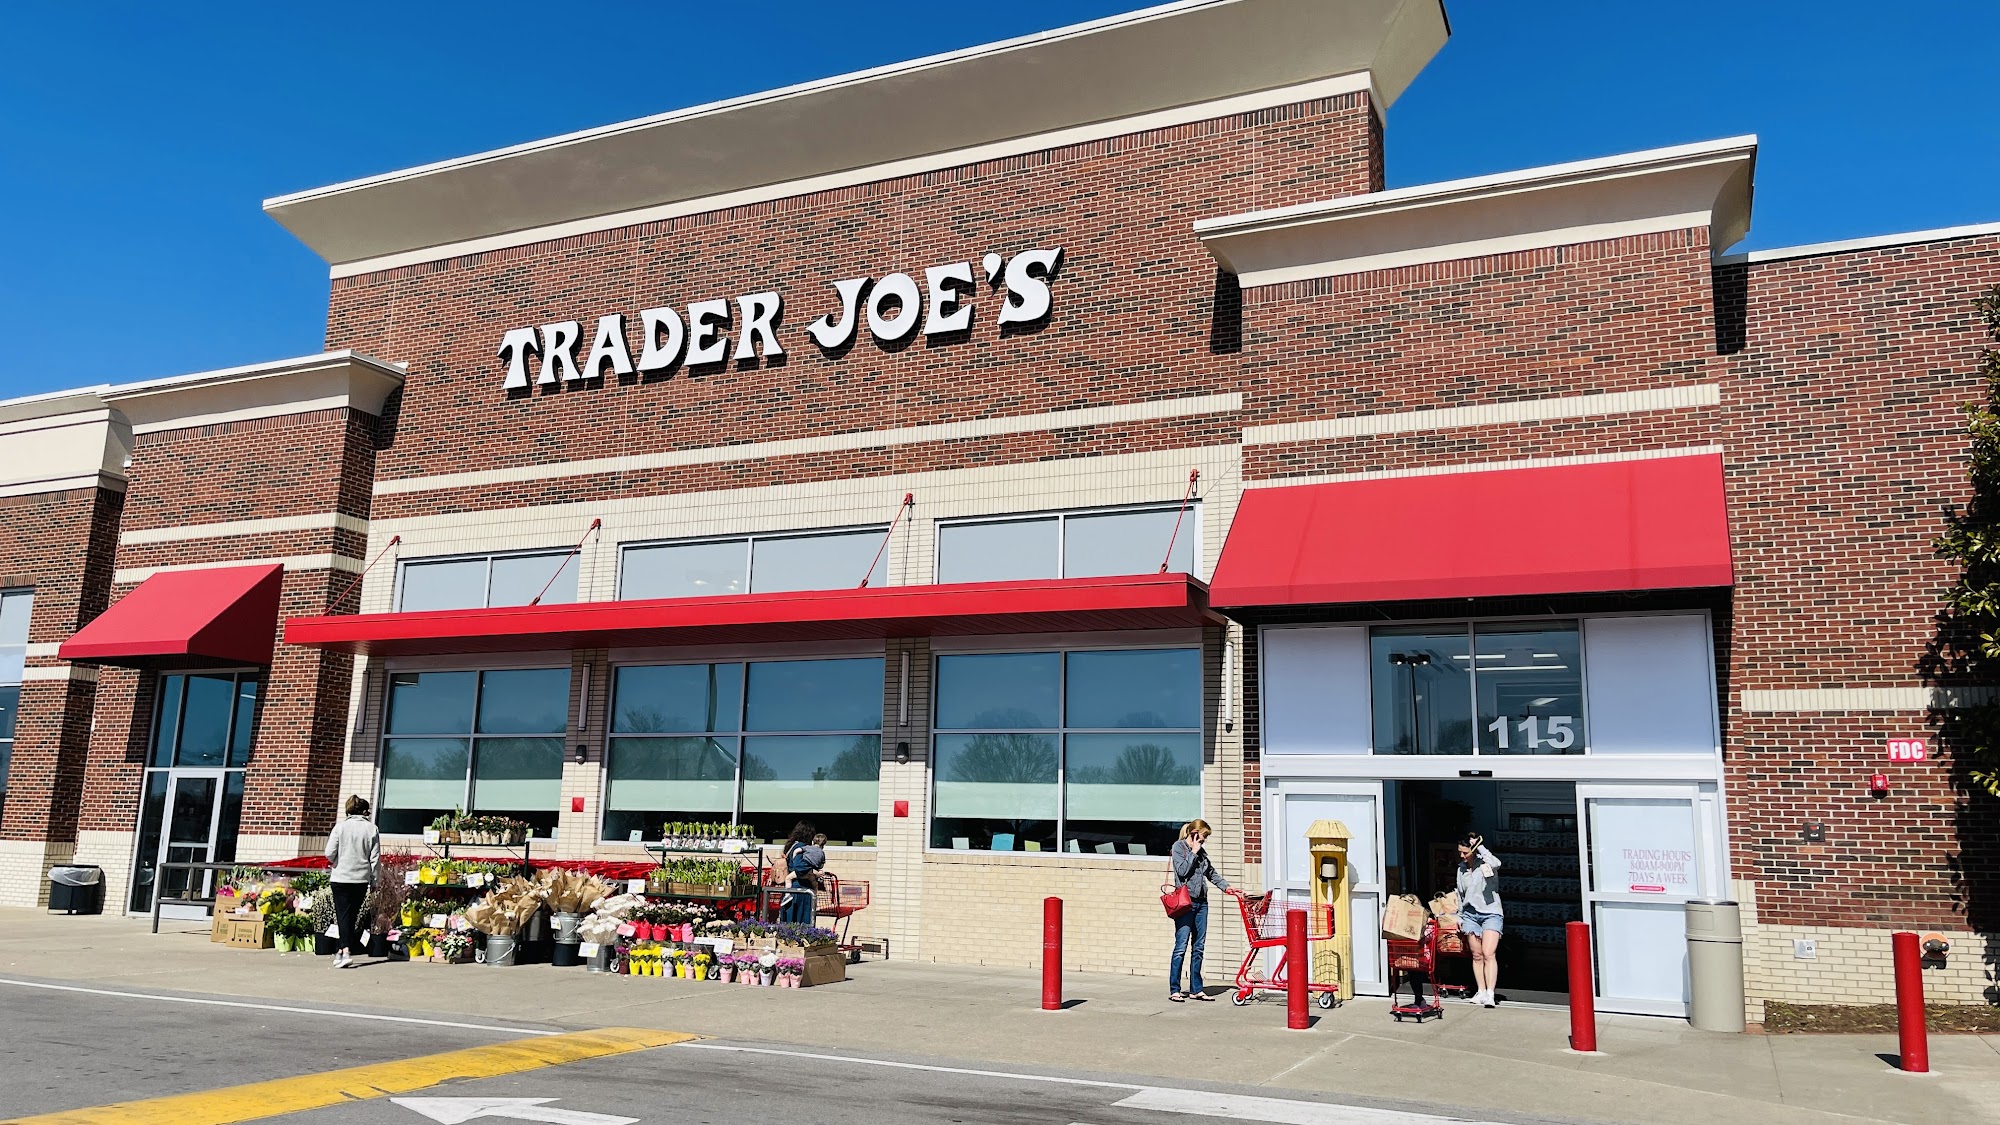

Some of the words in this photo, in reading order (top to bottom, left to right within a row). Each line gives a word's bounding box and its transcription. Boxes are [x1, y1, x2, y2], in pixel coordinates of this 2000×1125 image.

[498, 291, 785, 390] TRADER
[806, 247, 1063, 350] JOE'S
[1489, 716, 1574, 749] 115
[1890, 741, 1924, 759] FDC
[1622, 849, 1660, 860] TRADING
[1662, 850, 1691, 861] HOURS
[1664, 873, 1688, 883] WEEK
